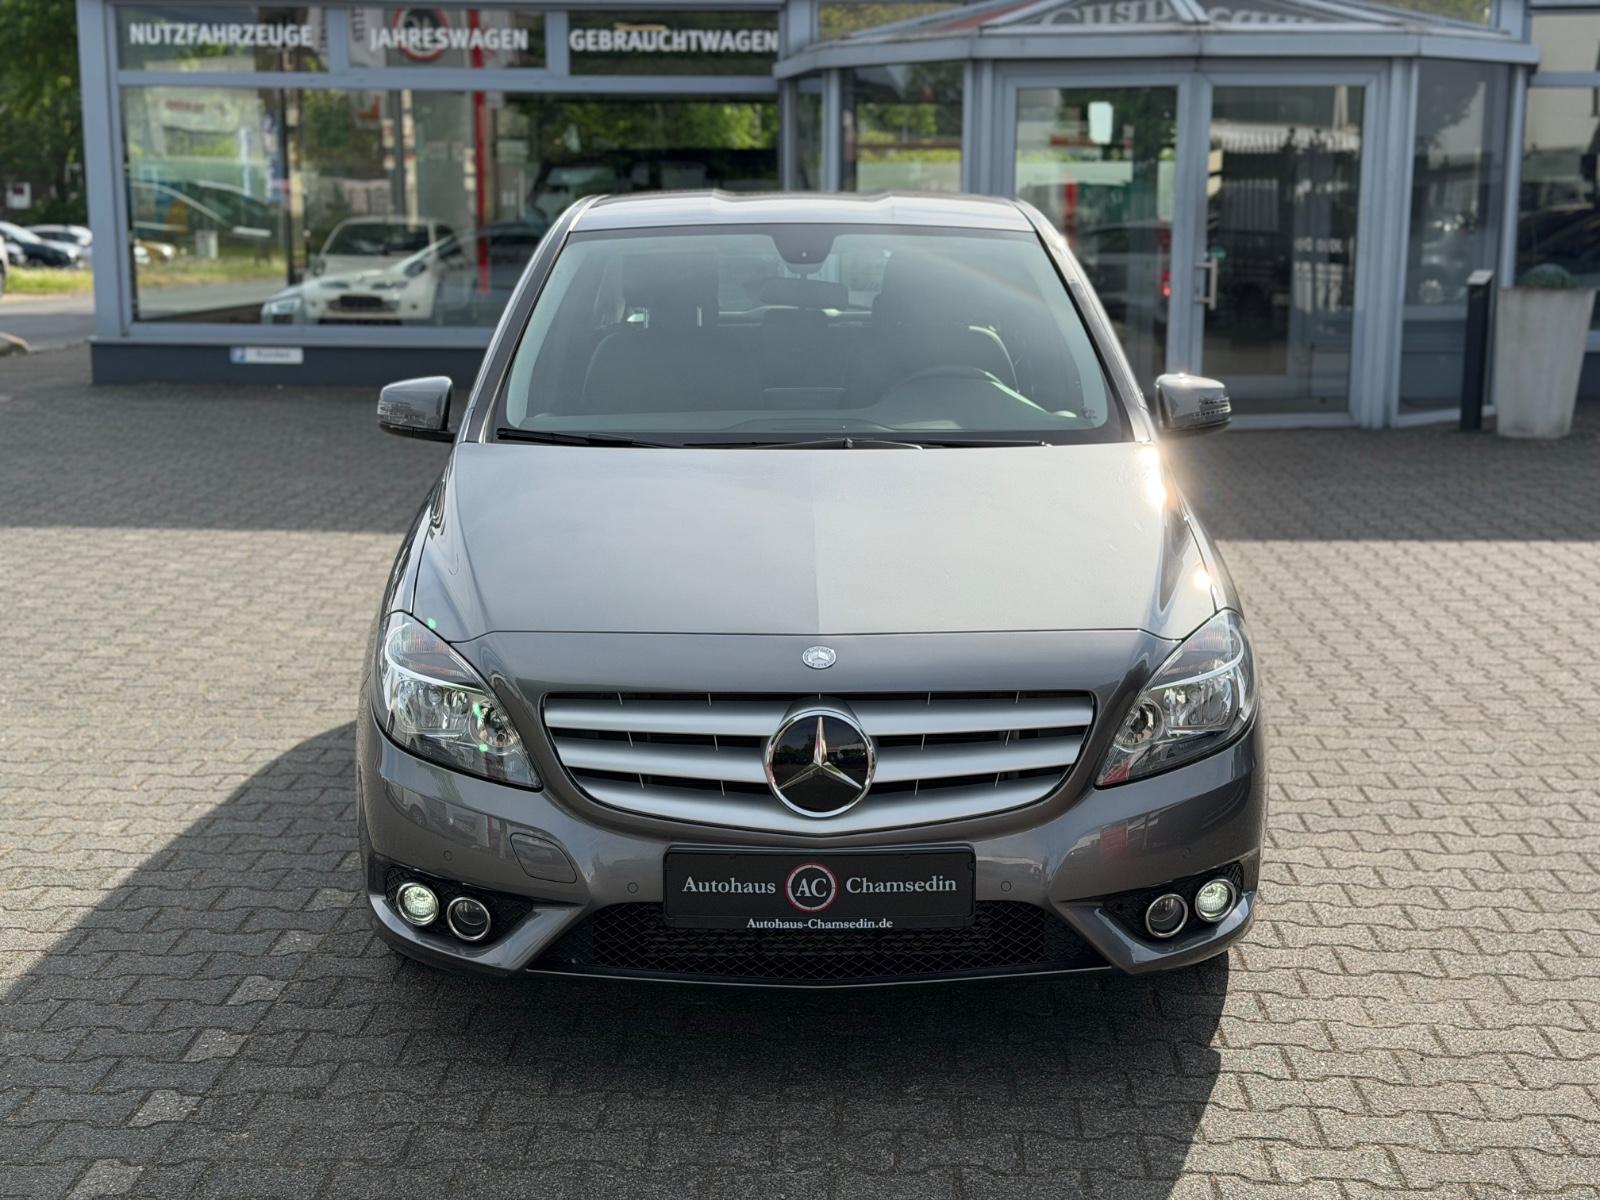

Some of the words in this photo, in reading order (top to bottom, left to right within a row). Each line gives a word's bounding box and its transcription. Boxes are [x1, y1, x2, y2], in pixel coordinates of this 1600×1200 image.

[129, 23, 313, 47] NUTZFAHRZEUGE
[369, 27, 529, 51] JAHRESWAGEN
[569, 28, 779, 53] GEBRAUCHTWAGEN
[682, 876, 776, 894] Autohaus
[795, 878, 827, 897] AC
[846, 876, 957, 894] Chamsedin
[747, 918, 893, 930] Autohaus-Chamsedin.de
